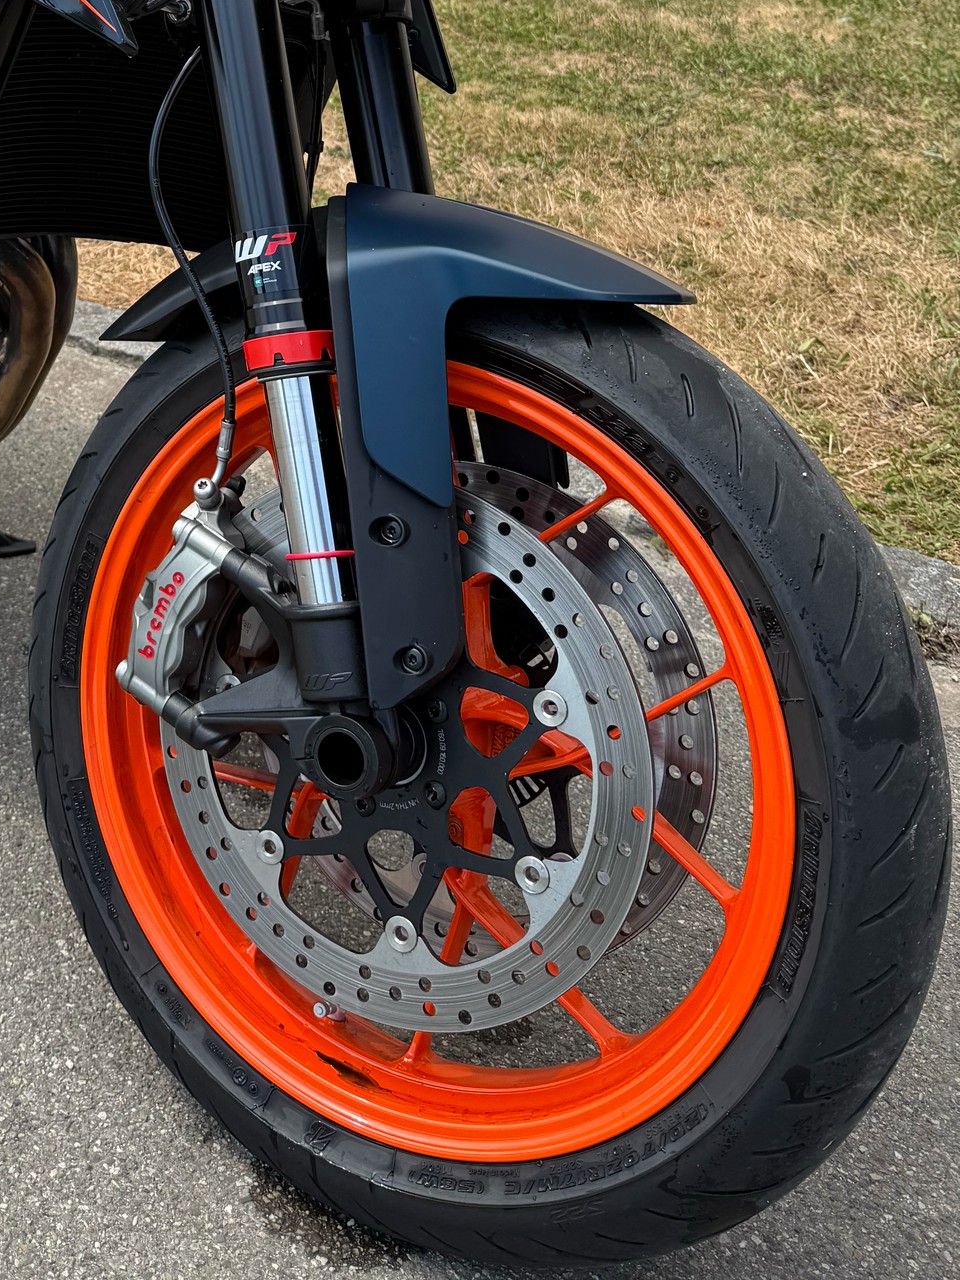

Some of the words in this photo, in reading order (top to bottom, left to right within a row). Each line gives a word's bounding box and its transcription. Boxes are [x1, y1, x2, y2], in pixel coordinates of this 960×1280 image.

[235, 232, 297, 263] WP
[247, 261, 282, 275] APEX
[138, 571, 184, 659] brembo
[777, 807, 823, 992] BRIDGESTONE
